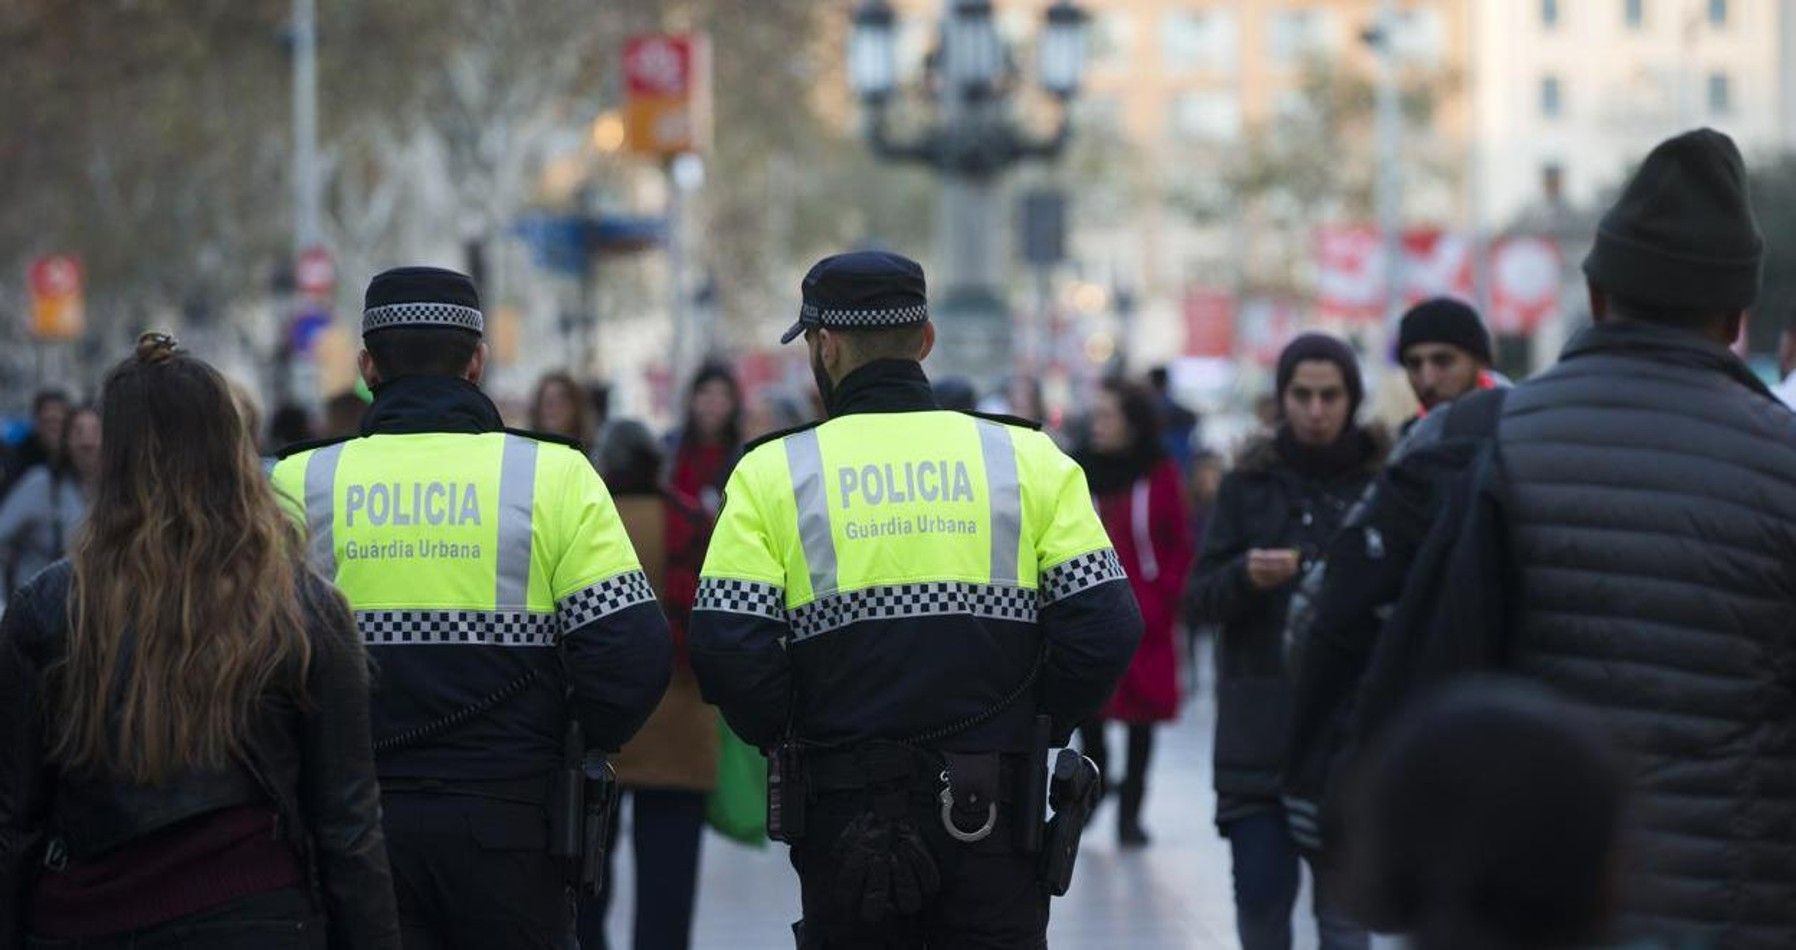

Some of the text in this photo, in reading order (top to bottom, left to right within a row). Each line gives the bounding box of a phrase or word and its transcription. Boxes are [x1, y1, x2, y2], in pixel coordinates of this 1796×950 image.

[838, 461, 974, 509] POLICIA
[346, 482, 481, 528] POLICIA
[917, 515, 976, 534] Urbana
[419, 539, 481, 558] Urbana
